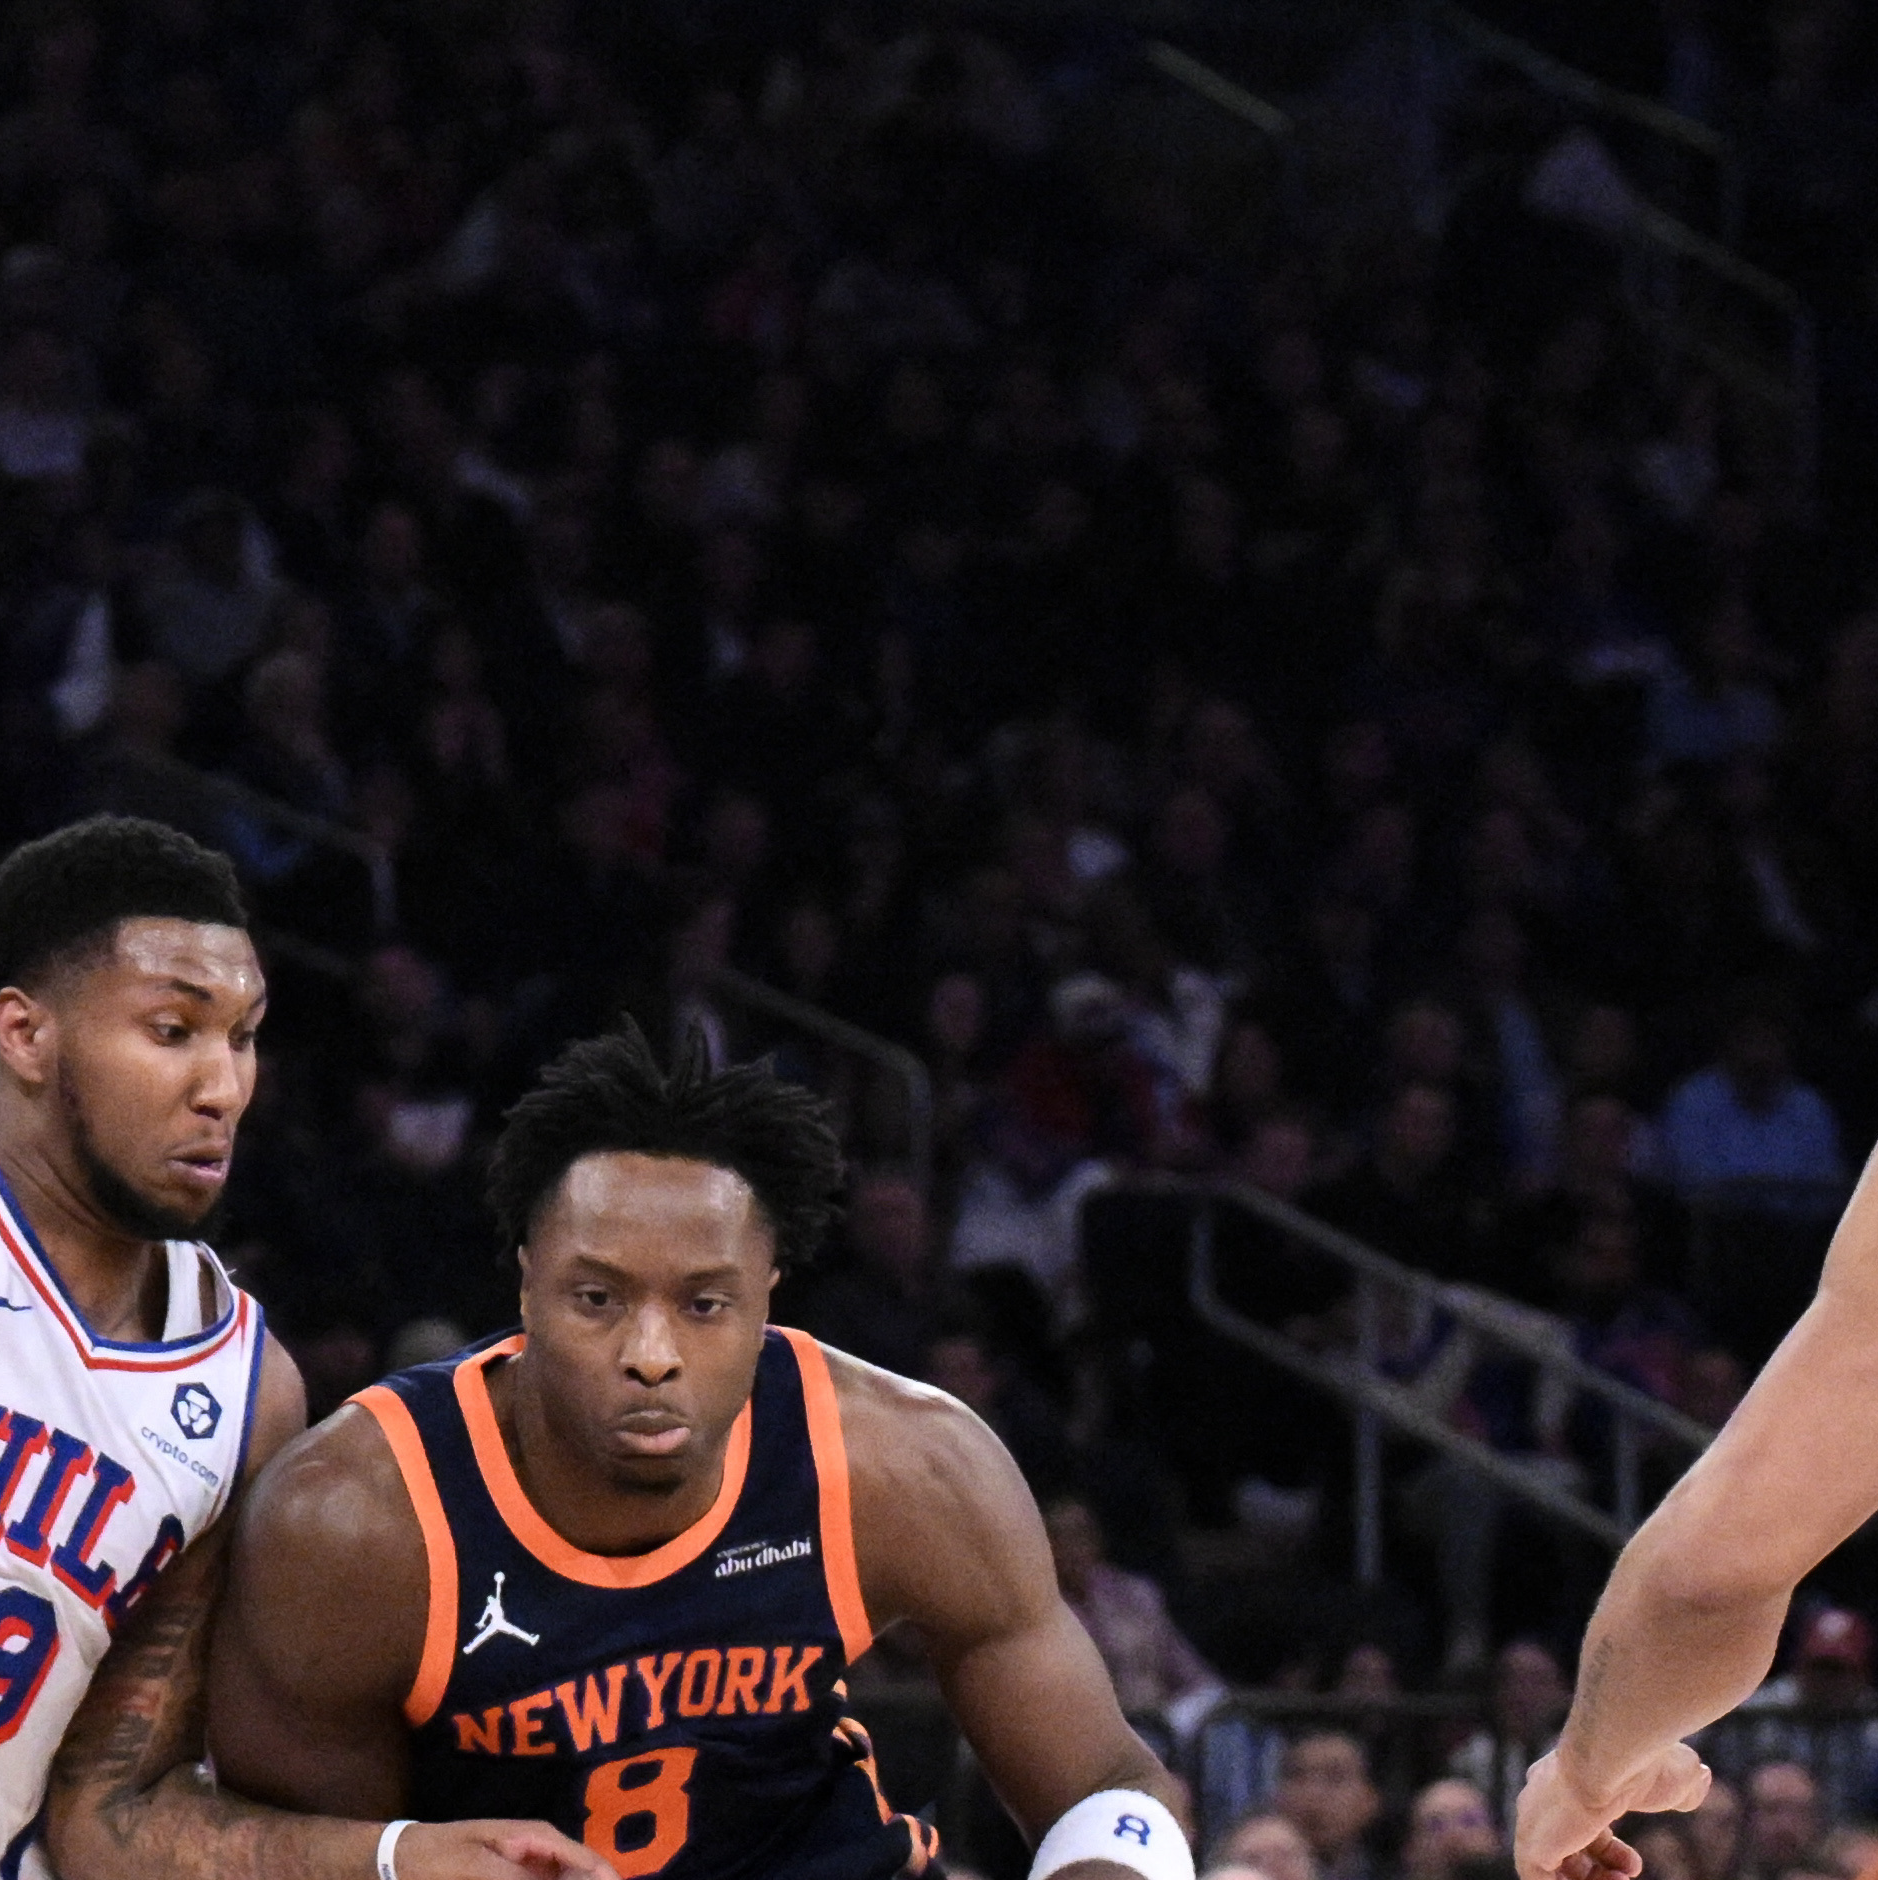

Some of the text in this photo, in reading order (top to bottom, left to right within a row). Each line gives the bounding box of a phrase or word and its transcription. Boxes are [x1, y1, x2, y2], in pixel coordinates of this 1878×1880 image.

[714, 1556, 753, 1578] abu
[755, 1536, 812, 1568] dhabi
[452, 1645, 824, 1757] NEW YORK
[582, 1746, 698, 1880] 8
